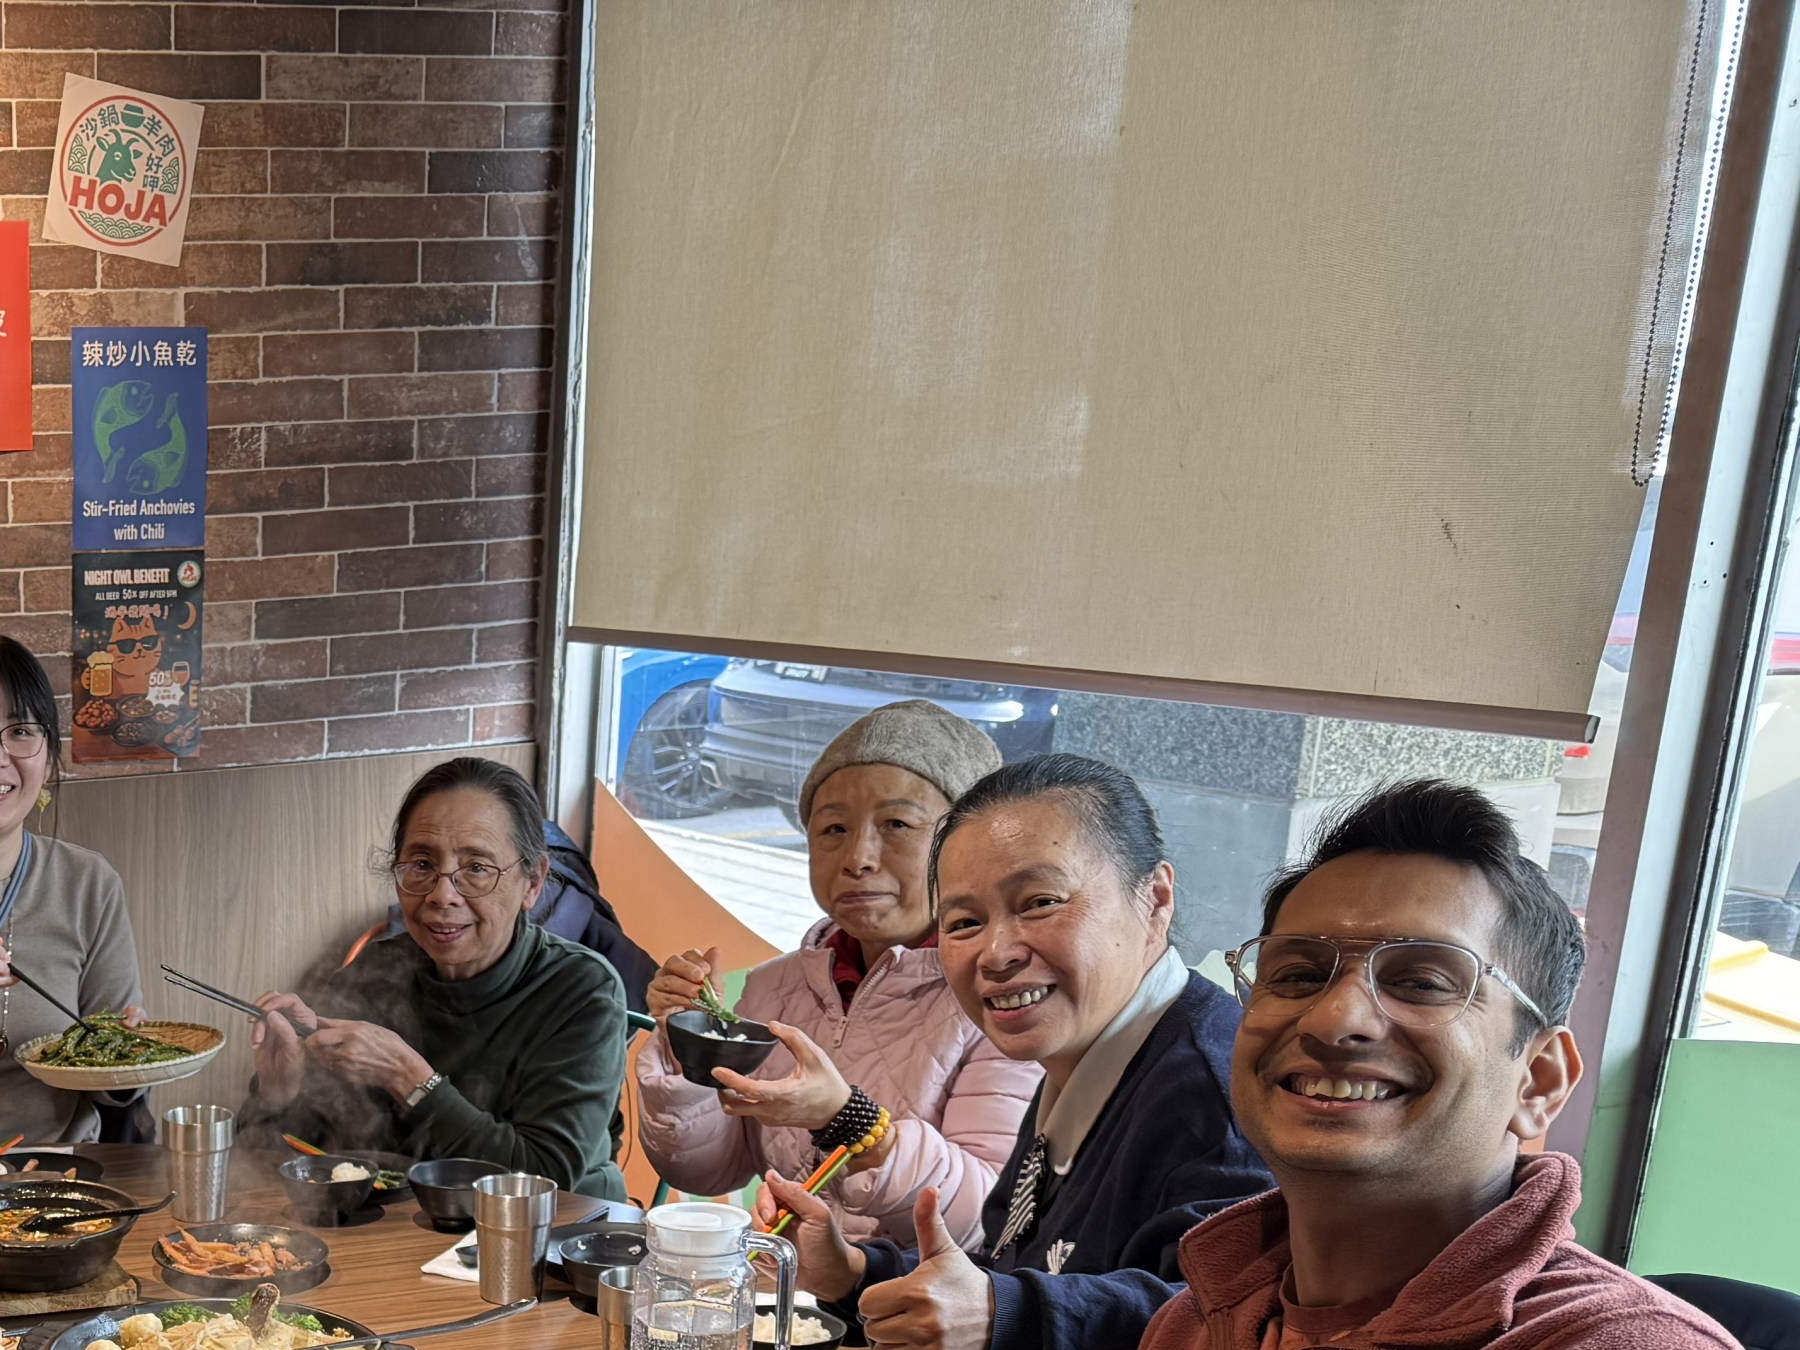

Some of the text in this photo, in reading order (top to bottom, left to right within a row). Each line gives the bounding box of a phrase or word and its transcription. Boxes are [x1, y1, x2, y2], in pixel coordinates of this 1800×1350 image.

[69, 175, 167, 227] HOJA
[82, 339, 197, 367] 辣炒小魚乾
[82, 499, 196, 517] Stir-Fried Anchovies
[114, 523, 165, 541] with Chili
[84, 570, 113, 586] NIGHT
[113, 569, 133, 585] OWL
[133, 568, 170, 584] BENEFIT
